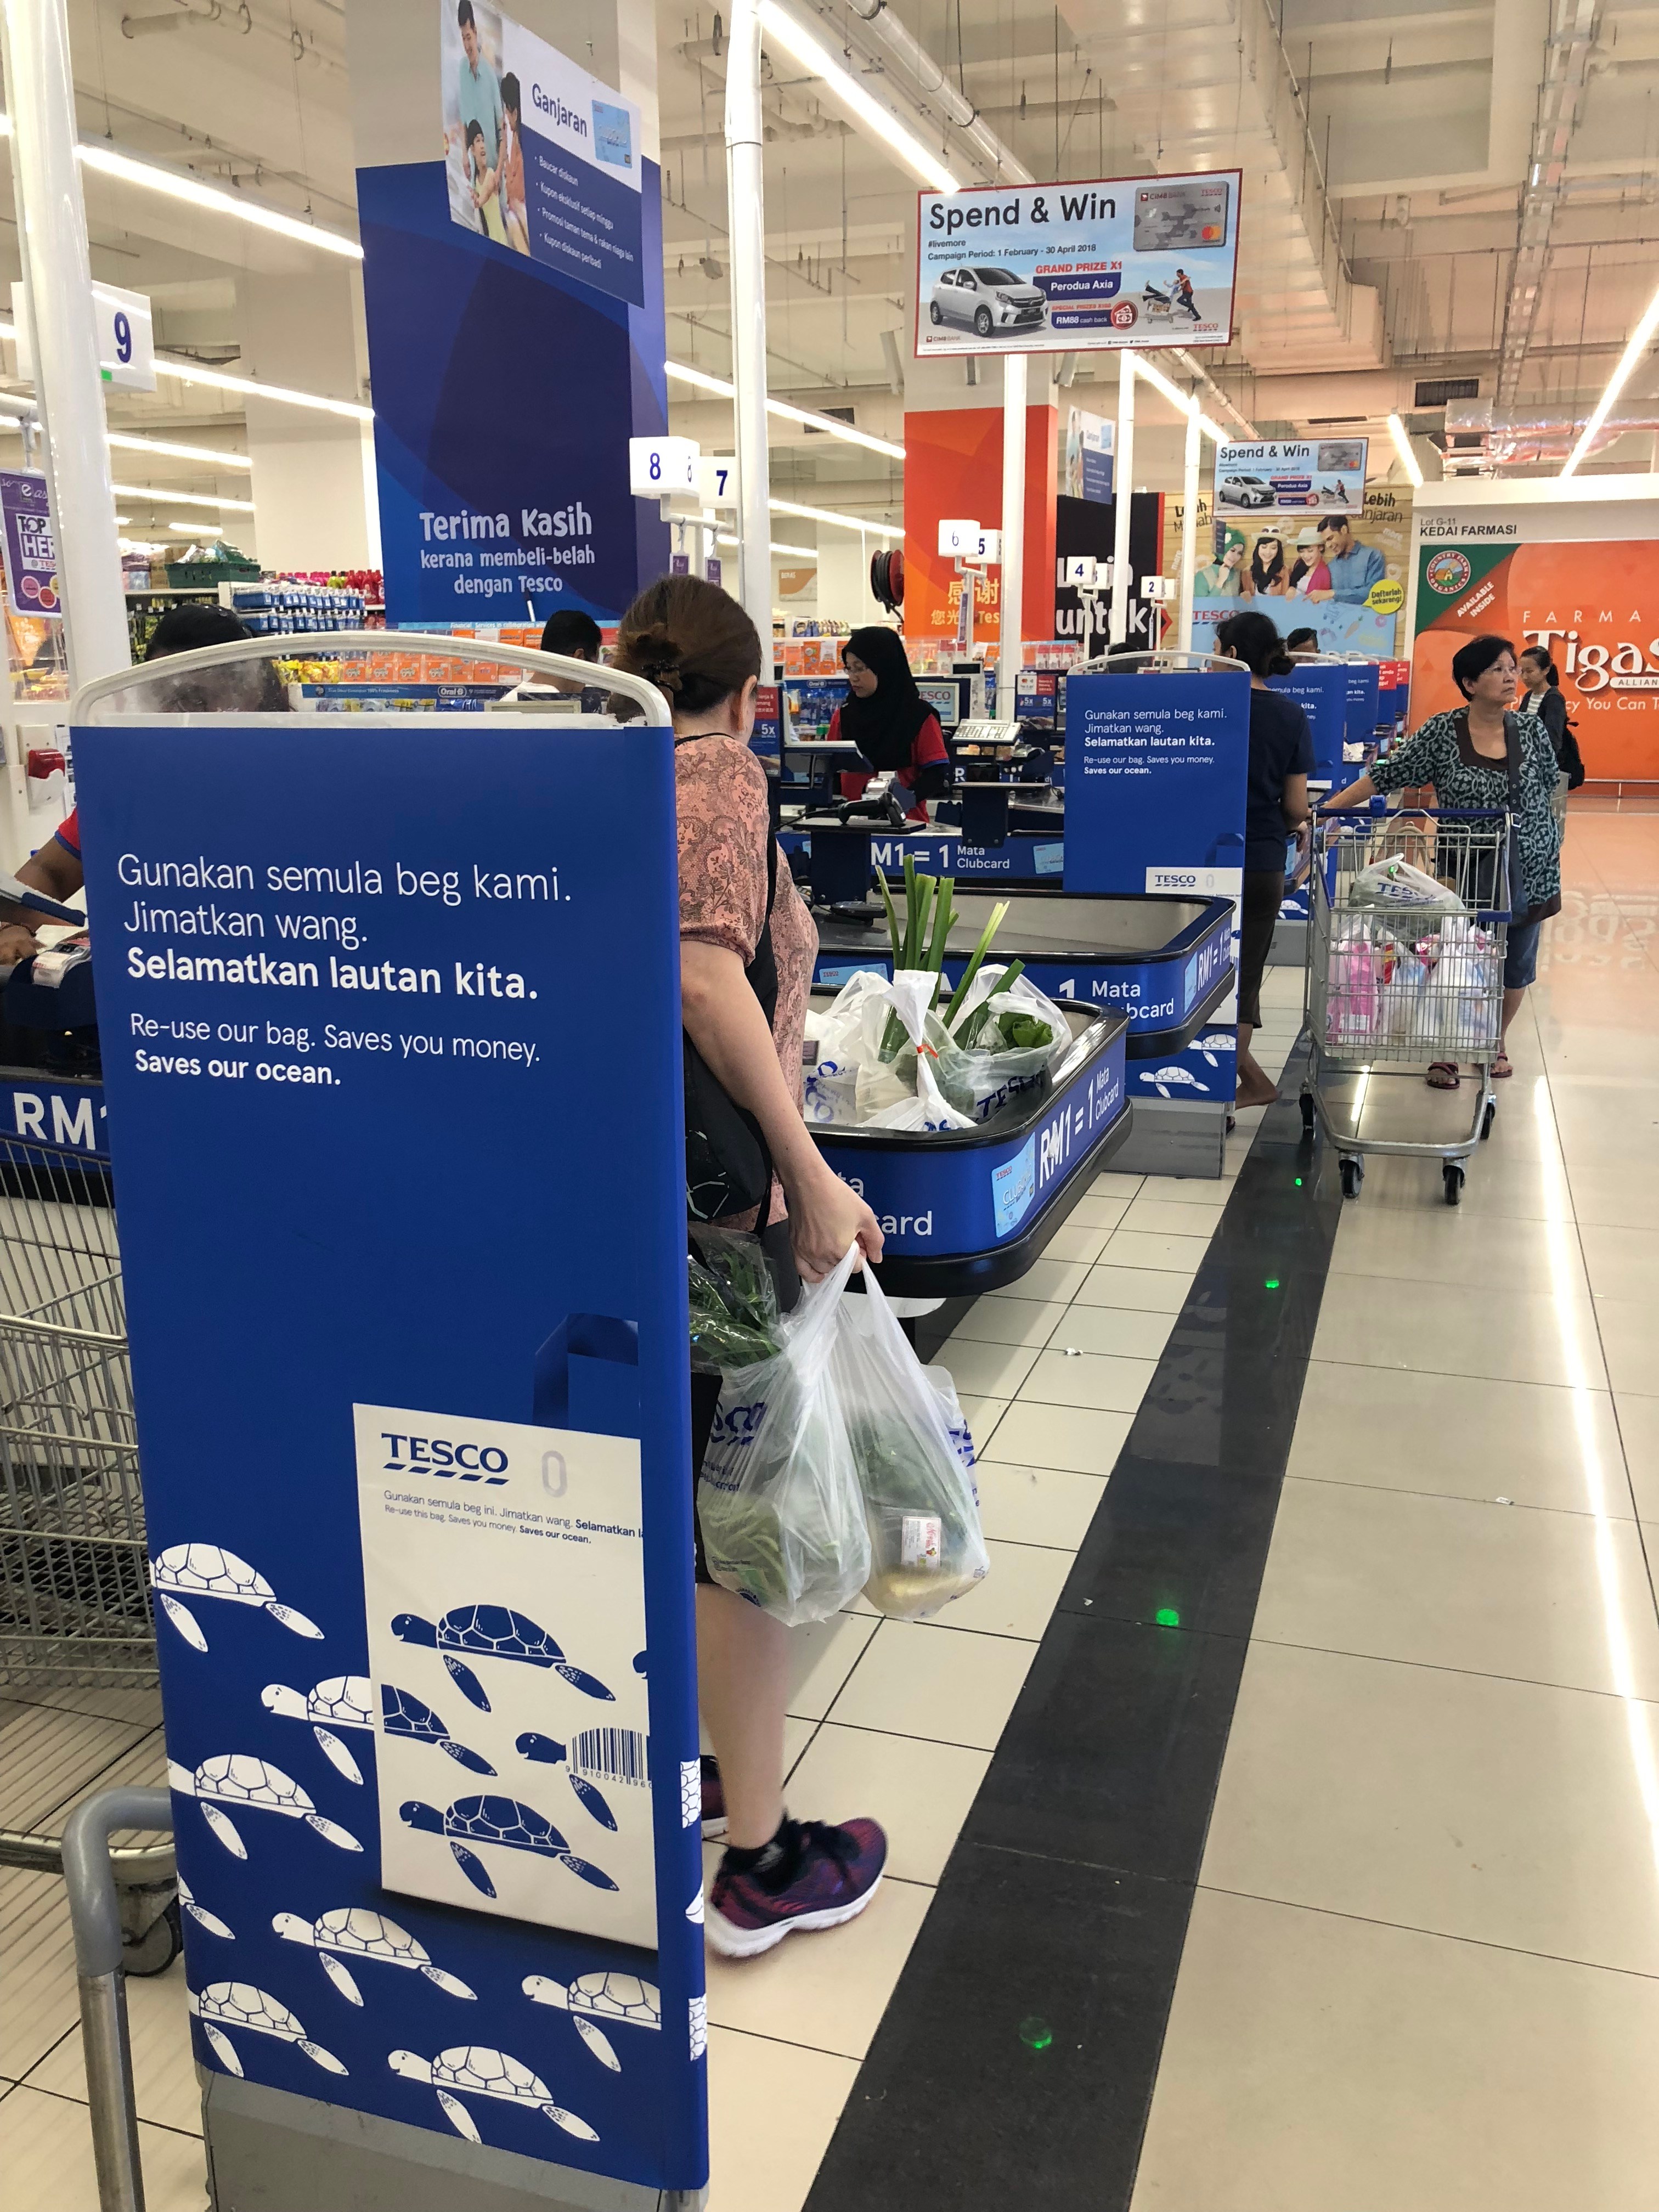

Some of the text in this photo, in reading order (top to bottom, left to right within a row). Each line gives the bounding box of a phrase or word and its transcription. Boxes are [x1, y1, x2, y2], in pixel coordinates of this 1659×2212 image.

[532, 83, 587, 137] Ganjaran
[541, 181, 558, 200] Kupon
[929, 193, 1116, 235] Spend & Win
[544, 232, 562, 249] Kupon
[928, 239, 966, 249] #livemore
[928, 252, 966, 261] Campaign
[968, 250, 996, 259] Period:
[1004, 248, 1039, 257] February
[1057, 245, 1075, 255] April
[1077, 244, 1096, 252] 2018
[1036, 261, 1122, 274] GRAND PRIZE X1
[1051, 279, 1114, 291] Perodua Axia
[1056, 316, 1079, 324] RM88
[114, 311, 132, 363] 9
[1220, 444, 1310, 461] Spend & Win
[650, 453, 661, 480] 8
[716, 470, 728, 496] 7
[18, 516, 46, 534] TOP
[419, 501, 592, 541] Terima Kasih
[1420, 517, 1457, 527] Lot G-11
[1420, 524, 1517, 537] KEDAI FARMASI
[978, 538, 985, 555] 5
[421, 544, 595, 568] kerana membeli-belah
[1457, 555, 1469, 572] FARM
[1075, 563, 1084, 577] 4
[454, 574, 563, 597] dengan Tesco
[1148, 582, 1154, 592] 2
[1372, 588, 1402, 599] Daftarlah
[1430, 578, 1466, 592] ORGANICS
[1372, 595, 1402, 605] sekarang!
[1457, 582, 1494, 617] AVAILABLE
[1470, 593, 1496, 617] INSIDE
[1293, 686, 1305, 695] beg
[1587, 697, 1611, 710] You
[1617, 696, 1646, 710] Can
[1085, 708, 1228, 721] Gunakan semula beg kami.
[761, 724, 775, 735] 5x
[1085, 723, 1164, 735] Jimatkan wang.
[1085, 736, 1215, 747] Selamatkan lautan kita.
[1128, 756, 1144, 765] bag.
[939, 844, 949, 868] 1
[957, 845, 985, 856] Mata
[957, 857, 1010, 869] Clubcard
[118, 853, 571, 906] Gunakan semula beg kami.
[1155, 875, 1196, 884] TESCO
[124, 901, 368, 950] Jimatkan wang.
[1198, 931, 1224, 991] RM1 1
[127, 946, 538, 1000] Selamatkan lautan kita.
[1092, 980, 1141, 997] Mata
[131, 1013, 540, 1068] Re-use our bag. Saves you money.
[134, 1048, 341, 1085] Saves our ocean.
[1096, 1066, 1109, 1093] Mata
[1096, 1077, 1119, 1121] Clubcard
[1040, 1103, 1071, 1189] RM1
[1088, 1079, 1093, 1130] 1
[996, 1165, 1013, 1179] TESCO
[381, 1432, 509, 1473] TESCO
[384, 1489, 425, 1505] Gunakan
[427, 1498, 461, 1510] semula
[464, 1502, 482, 1516] beg
[484, 1505, 498, 1516] ini.
[500, 1508, 543, 1523] Jimatkan
[546, 1515, 574, 1530] wang.
[575, 1519, 636, 1537] Selamatkan
[385, 1504, 413, 1516] Re-use
[414, 1509, 428, 1519] this
[430, 1511, 447, 1523] bag.
[448, 1514, 471, 1525] Saves
[472, 1519, 487, 1528] you
[519, 1525, 544, 1536] Saves
[545, 1530, 560, 1539] our
[562, 1533, 592, 1544] ocean.
